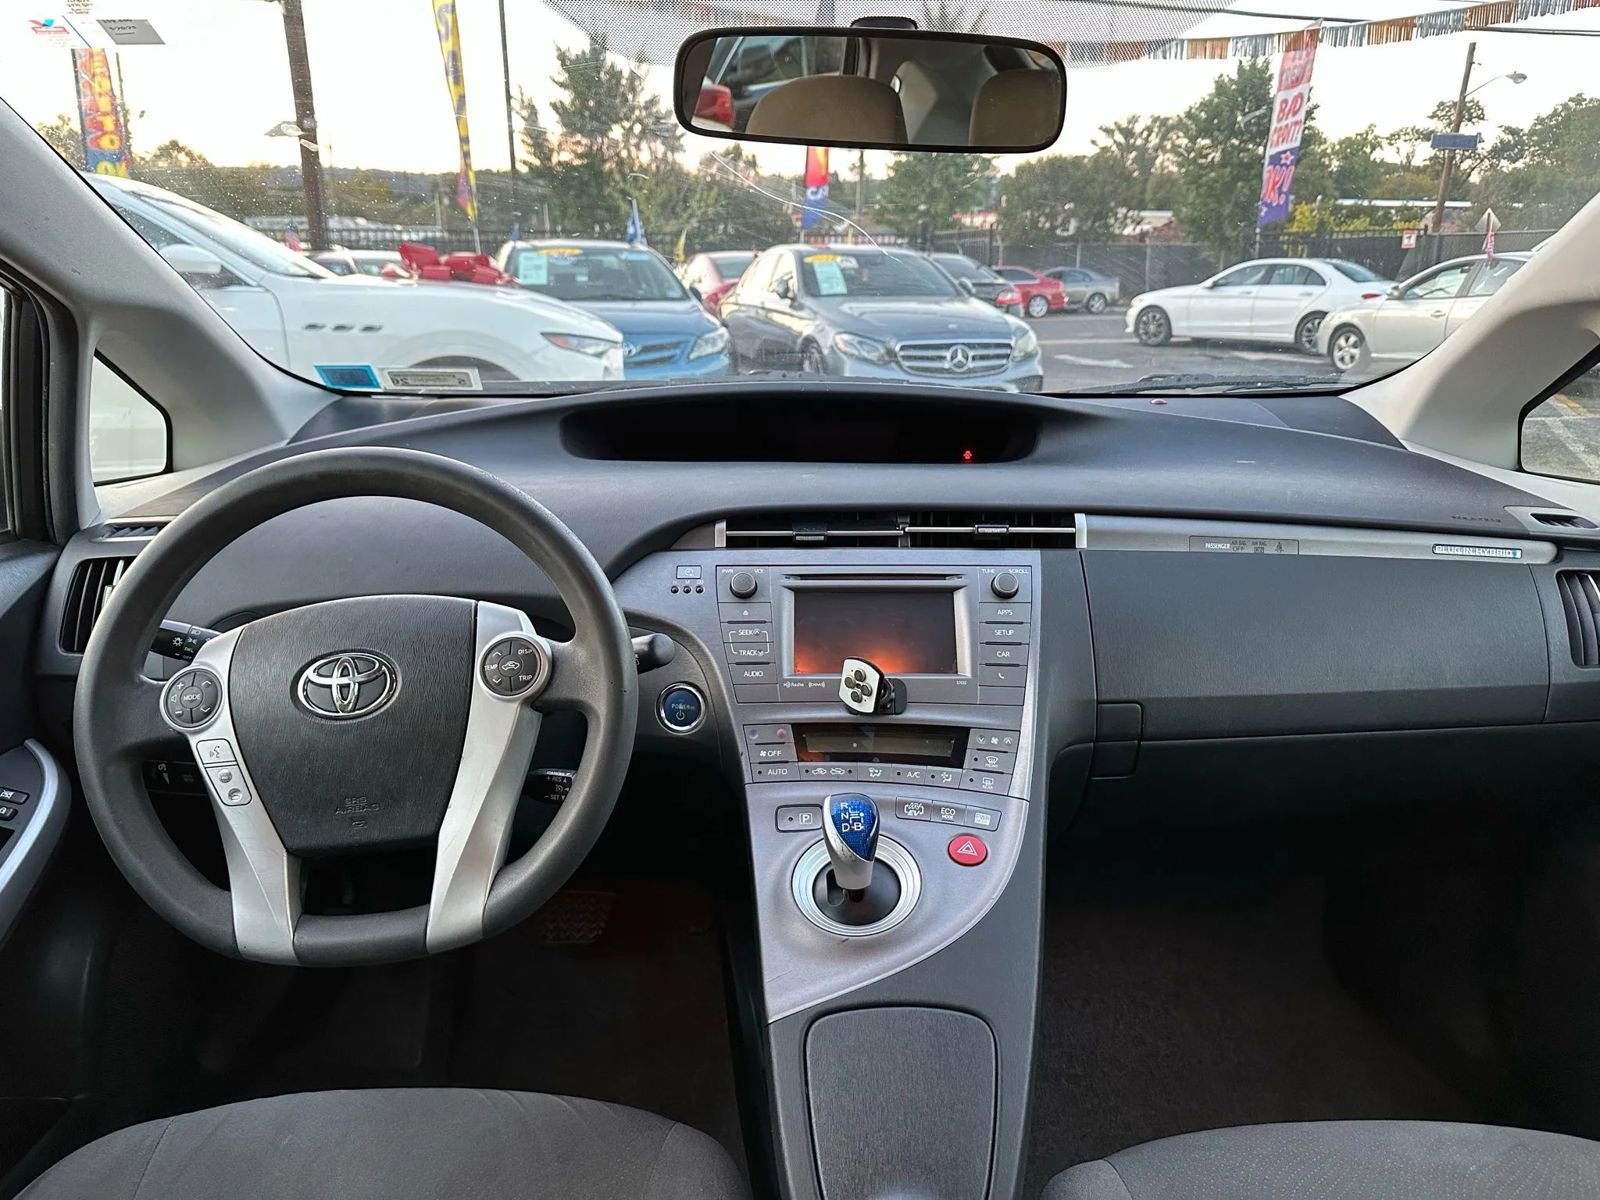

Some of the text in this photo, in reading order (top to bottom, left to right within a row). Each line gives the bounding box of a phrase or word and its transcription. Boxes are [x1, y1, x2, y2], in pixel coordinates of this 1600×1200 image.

[739, 649, 757, 657] TRACK
[996, 650, 1010, 658] CAR
[484, 663, 498, 671] TEMP
[518, 674, 533, 682] TRIP
[743, 670, 764, 678] AUDIO
[183, 693, 201, 701] MODE
[767, 749, 782, 757] OFF
[767, 768, 788, 776] AUTO
[906, 771, 921, 779] A/C
[840, 802, 849, 810] R
[940, 807, 956, 816] ECO
[841, 812, 849, 820] N
[841, 822, 862, 832] D B
